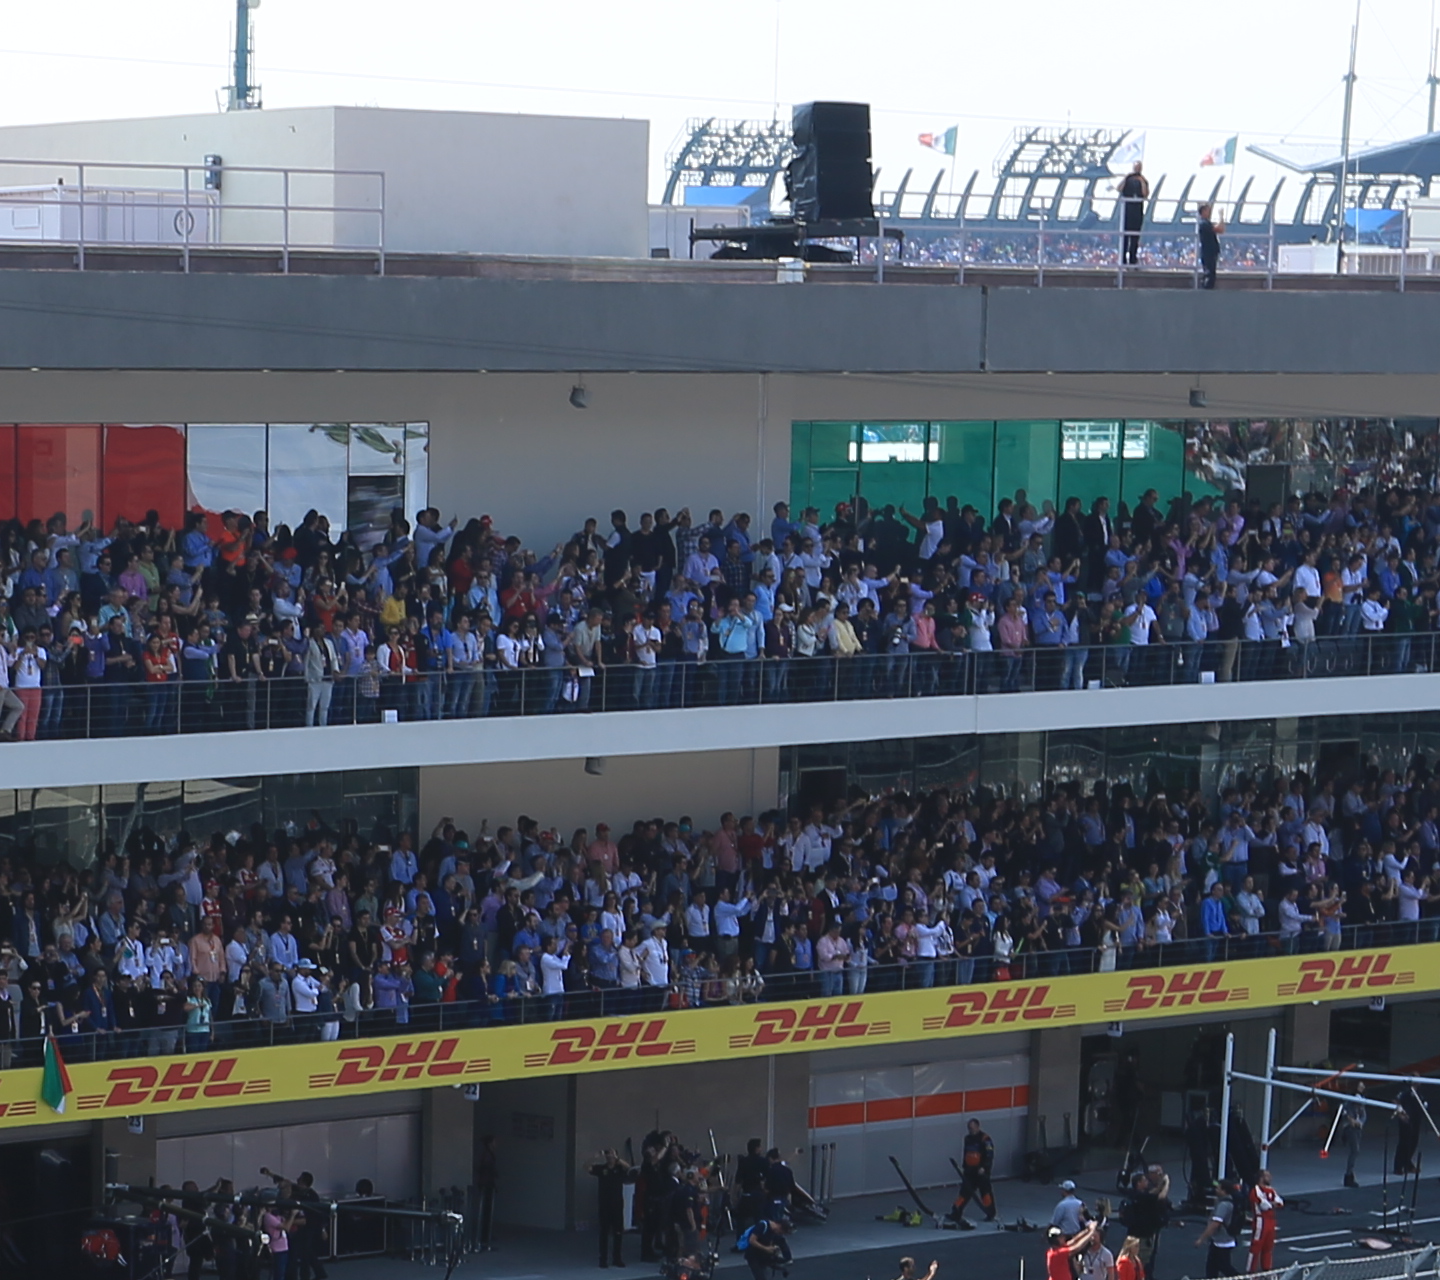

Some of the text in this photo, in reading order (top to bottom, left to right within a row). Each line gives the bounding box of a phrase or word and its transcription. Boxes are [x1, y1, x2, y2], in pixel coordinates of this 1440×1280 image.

[1125, 970, 1230, 1010] DHL
[1297, 954, 1396, 994] DHL
[752, 1002, 869, 1046] DHL
[945, 986, 1055, 1028] DHL
[335, 1038, 466, 1086] DHL
[549, 1019, 672, 1065] DHL
[105, 1058, 245, 1107] DHL
